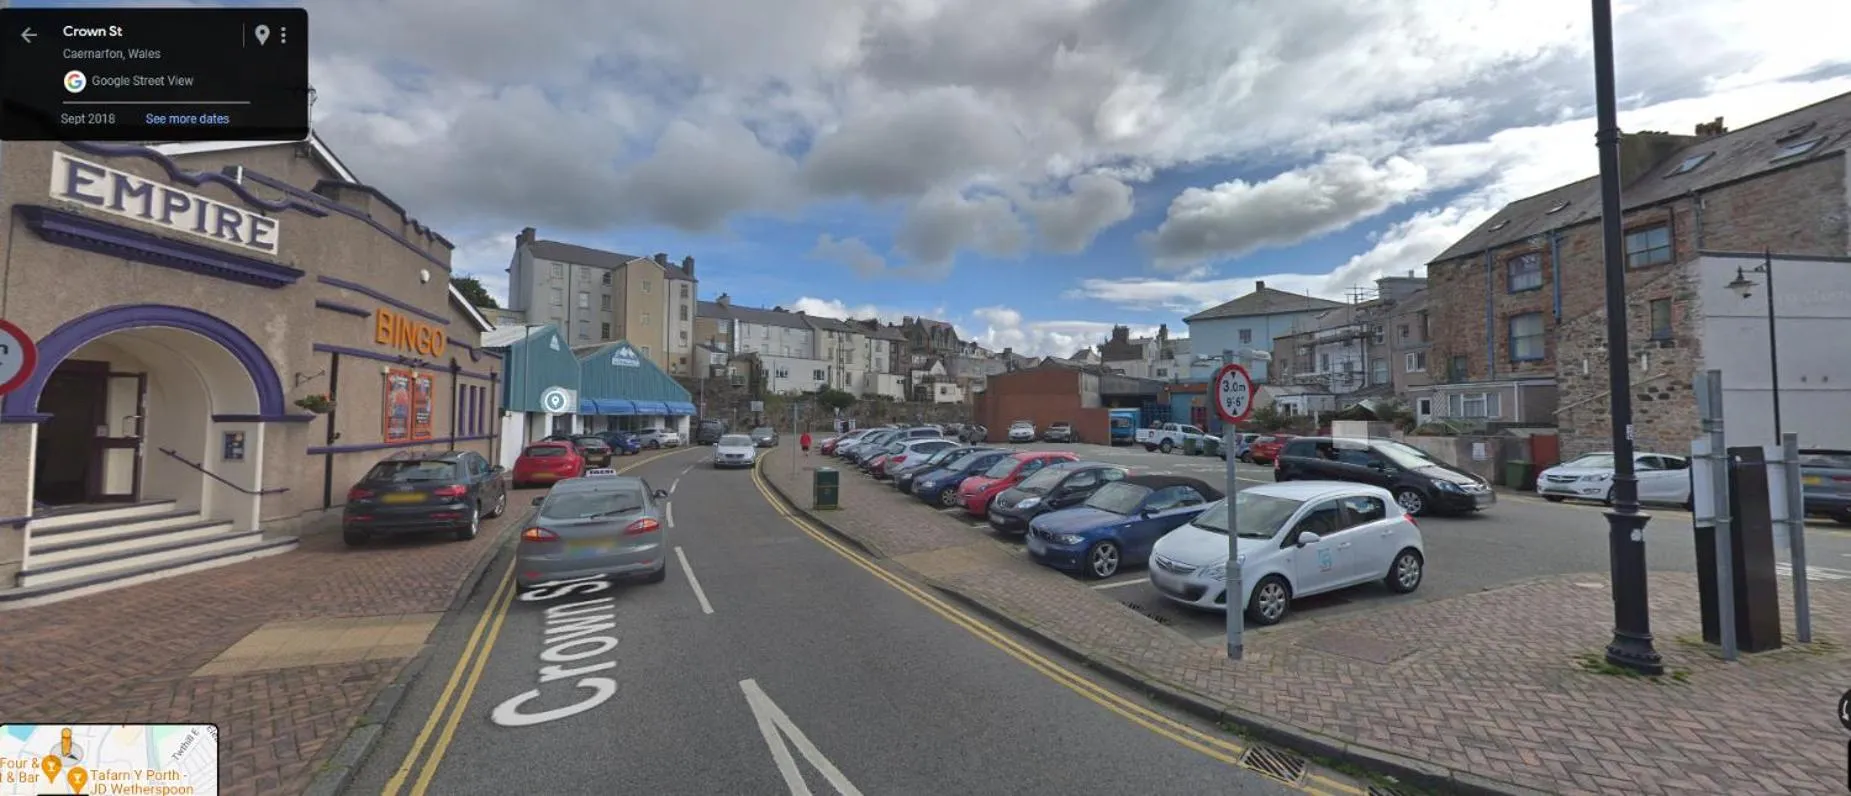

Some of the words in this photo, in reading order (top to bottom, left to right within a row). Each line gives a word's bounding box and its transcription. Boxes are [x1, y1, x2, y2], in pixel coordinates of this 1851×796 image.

[60, 155, 277, 251] EMPIRE
[375, 307, 446, 357] BINGO
[1222, 380, 1246, 393] 3.0m
